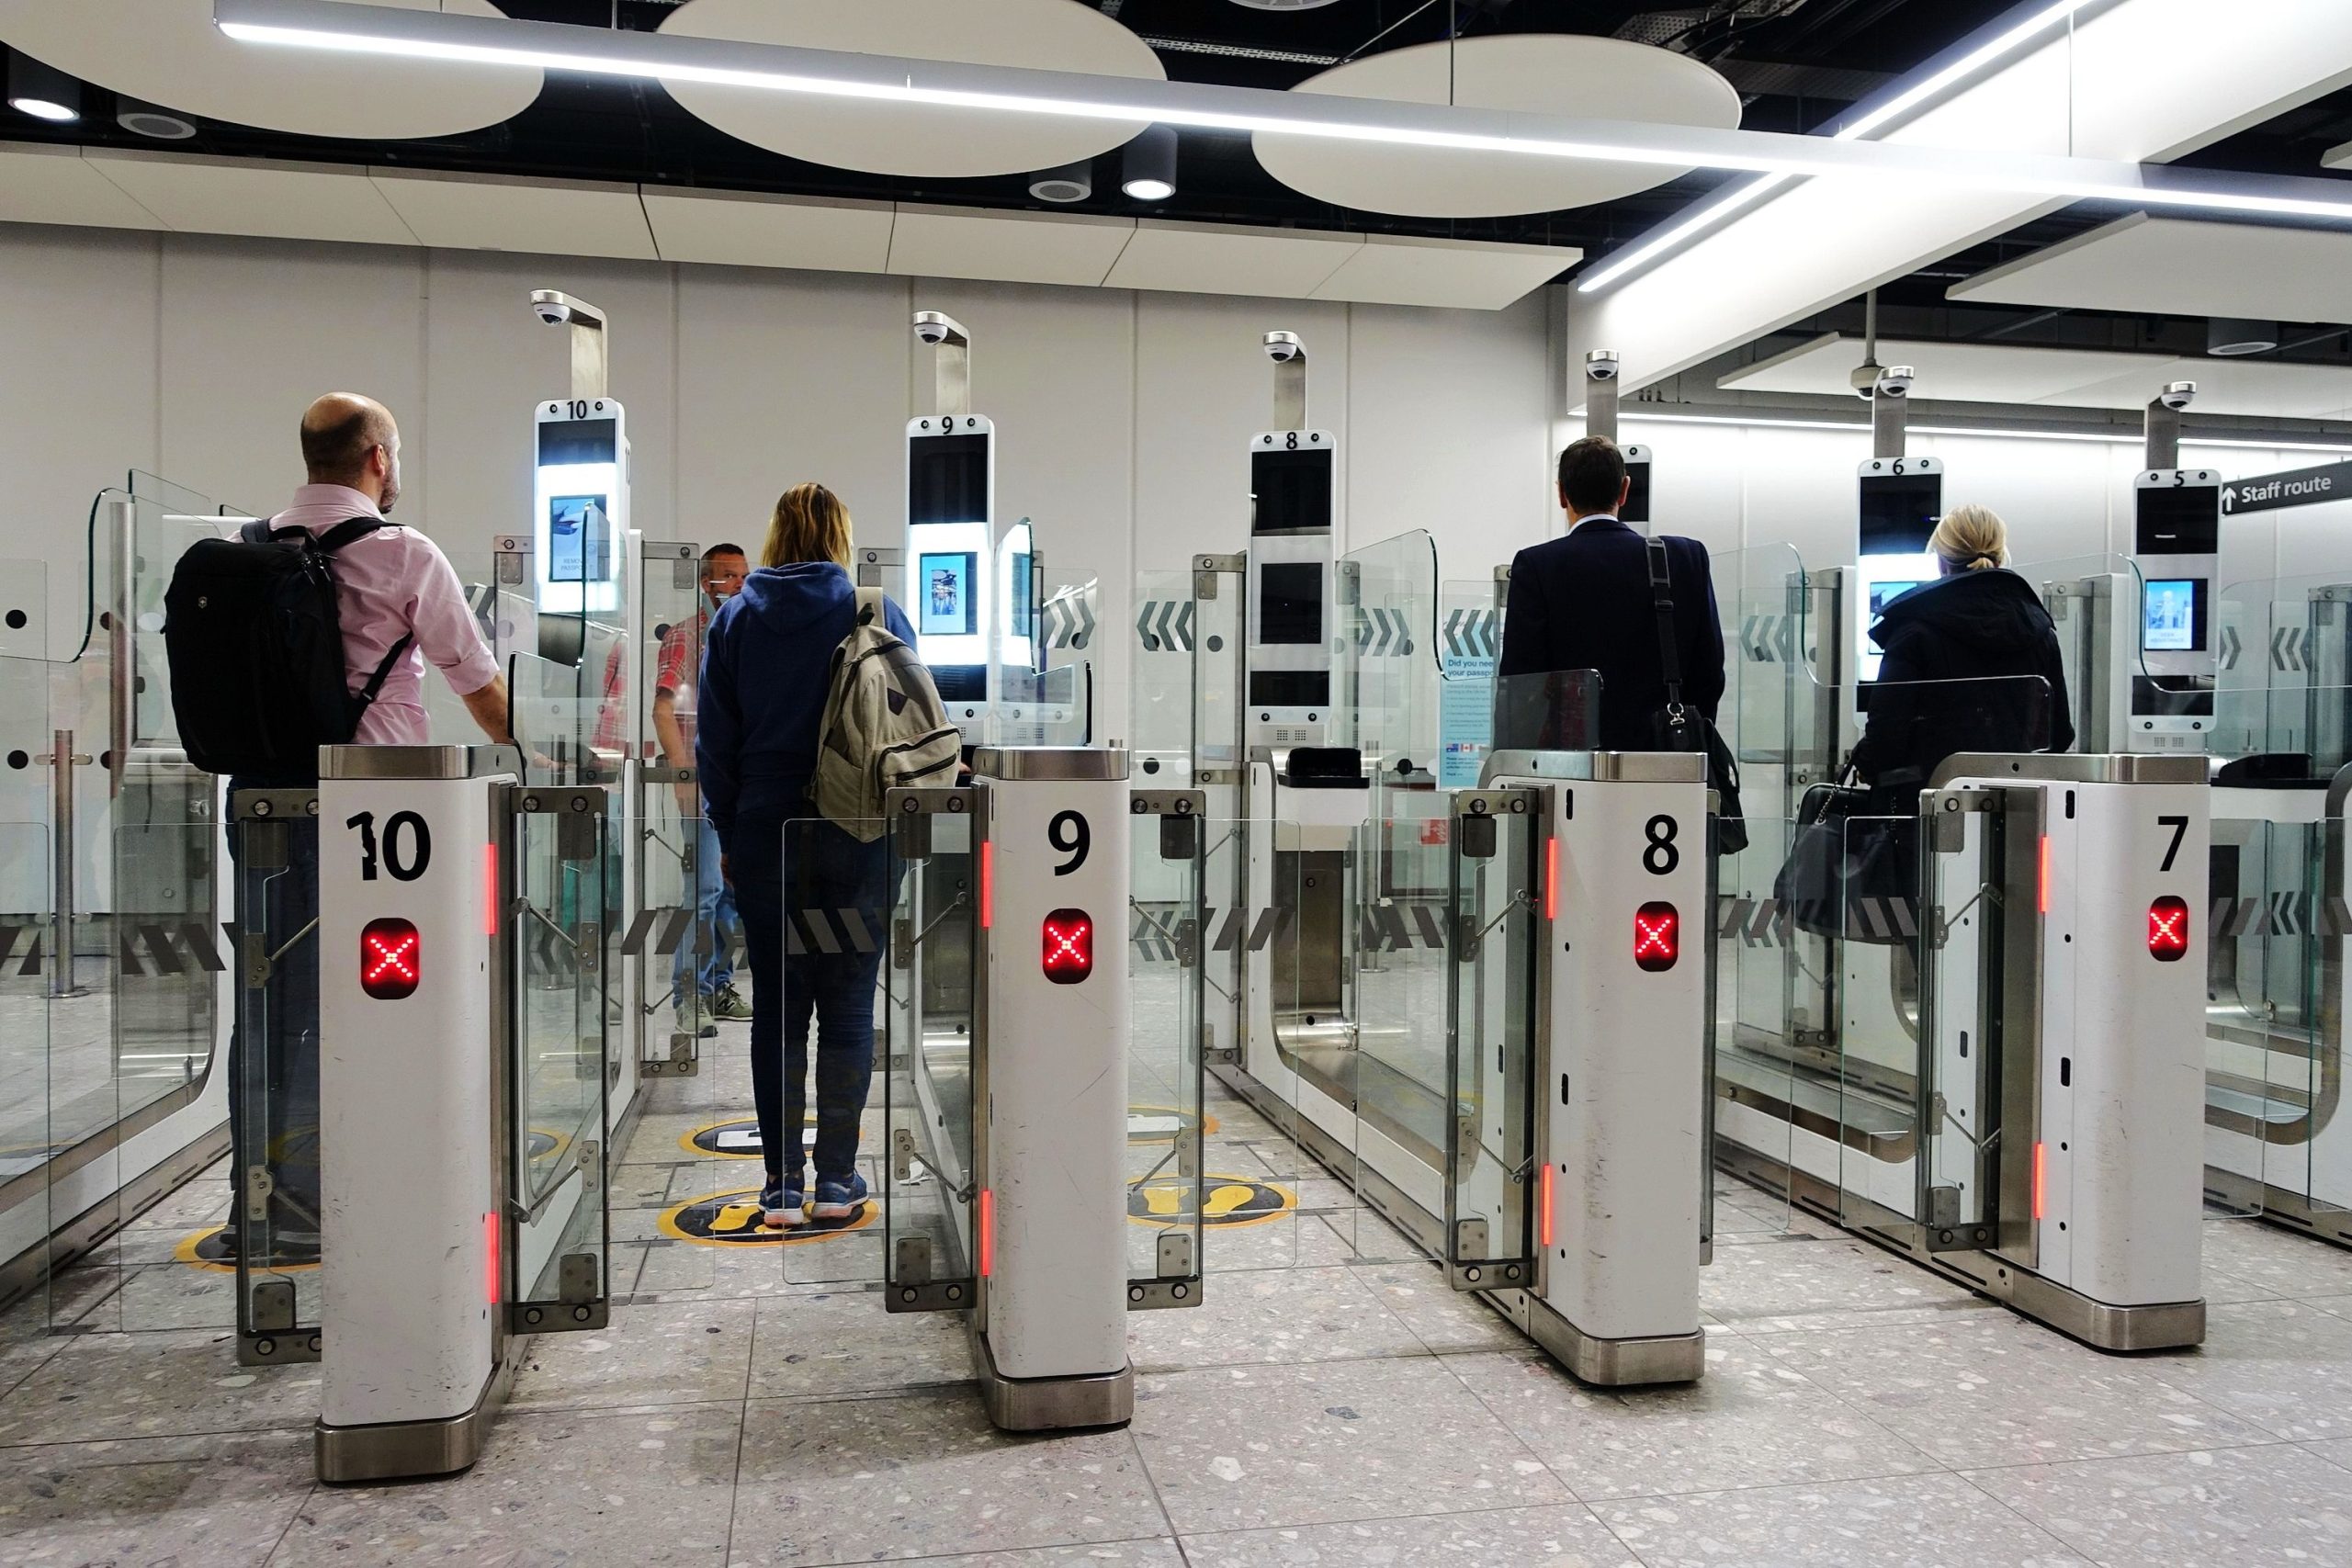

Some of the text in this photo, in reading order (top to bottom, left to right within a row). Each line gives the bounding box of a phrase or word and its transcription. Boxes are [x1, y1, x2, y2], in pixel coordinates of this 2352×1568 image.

[567, 400, 588, 420] 10
[942, 416, 954, 435] 9
[1286, 432, 1297, 450] 8
[1893, 458, 1904, 476] 6
[2174, 470, 2185, 487] 5
[2241, 476, 2332, 503] Staff route
[1448, 659, 1462, 667] Did
[1464, 660, 1477, 669] you
[346, 810, 431, 882] 10
[1047, 809, 1091, 876] 9
[1643, 814, 1679, 875] 8
[2157, 816, 2188, 872] 7
